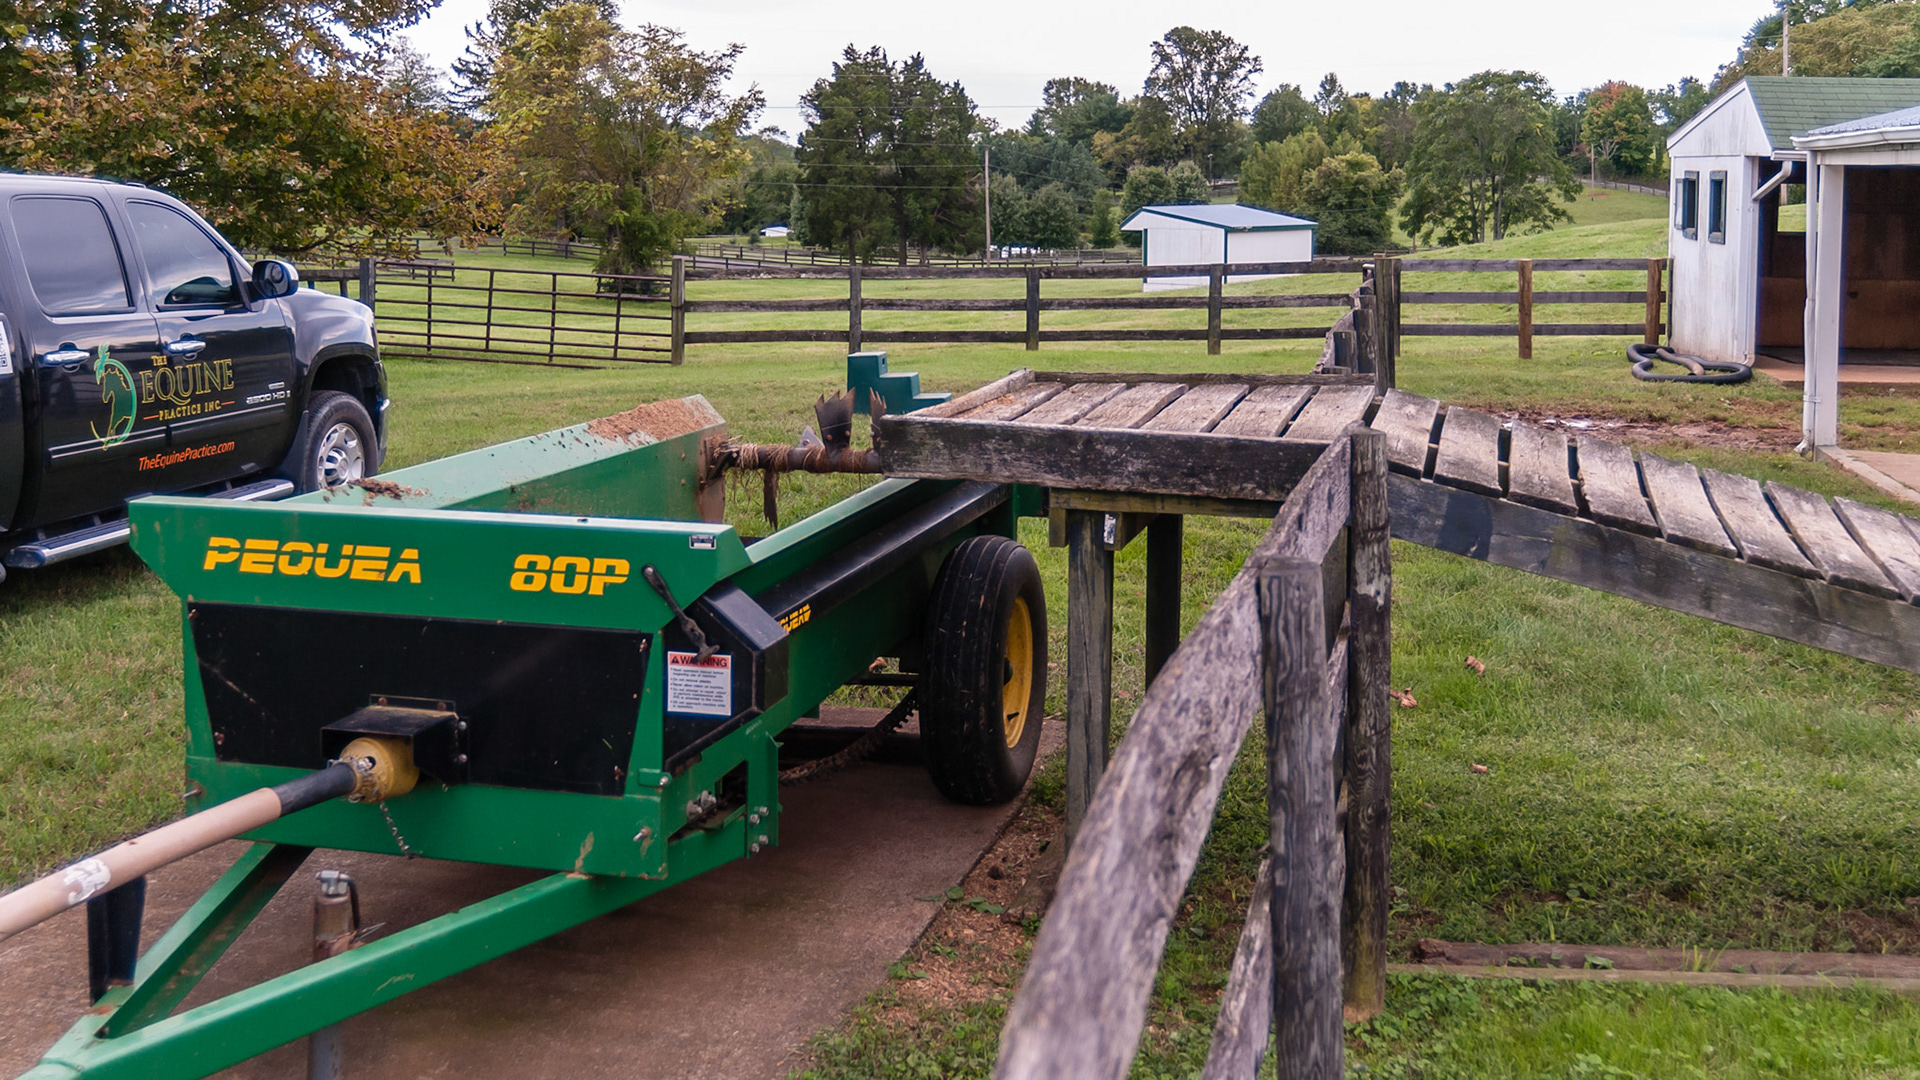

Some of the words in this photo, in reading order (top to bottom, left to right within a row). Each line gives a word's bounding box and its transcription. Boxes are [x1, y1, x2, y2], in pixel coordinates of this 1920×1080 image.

[151, 355, 167, 366] THE
[139, 358, 235, 406] EQUINE
[158, 404, 201, 421] PRACTICE
[138, 441, 236, 472] TheEquinePractice.com
[203, 536, 422, 584] PEQUEA
[509, 553, 631, 596] 80P
